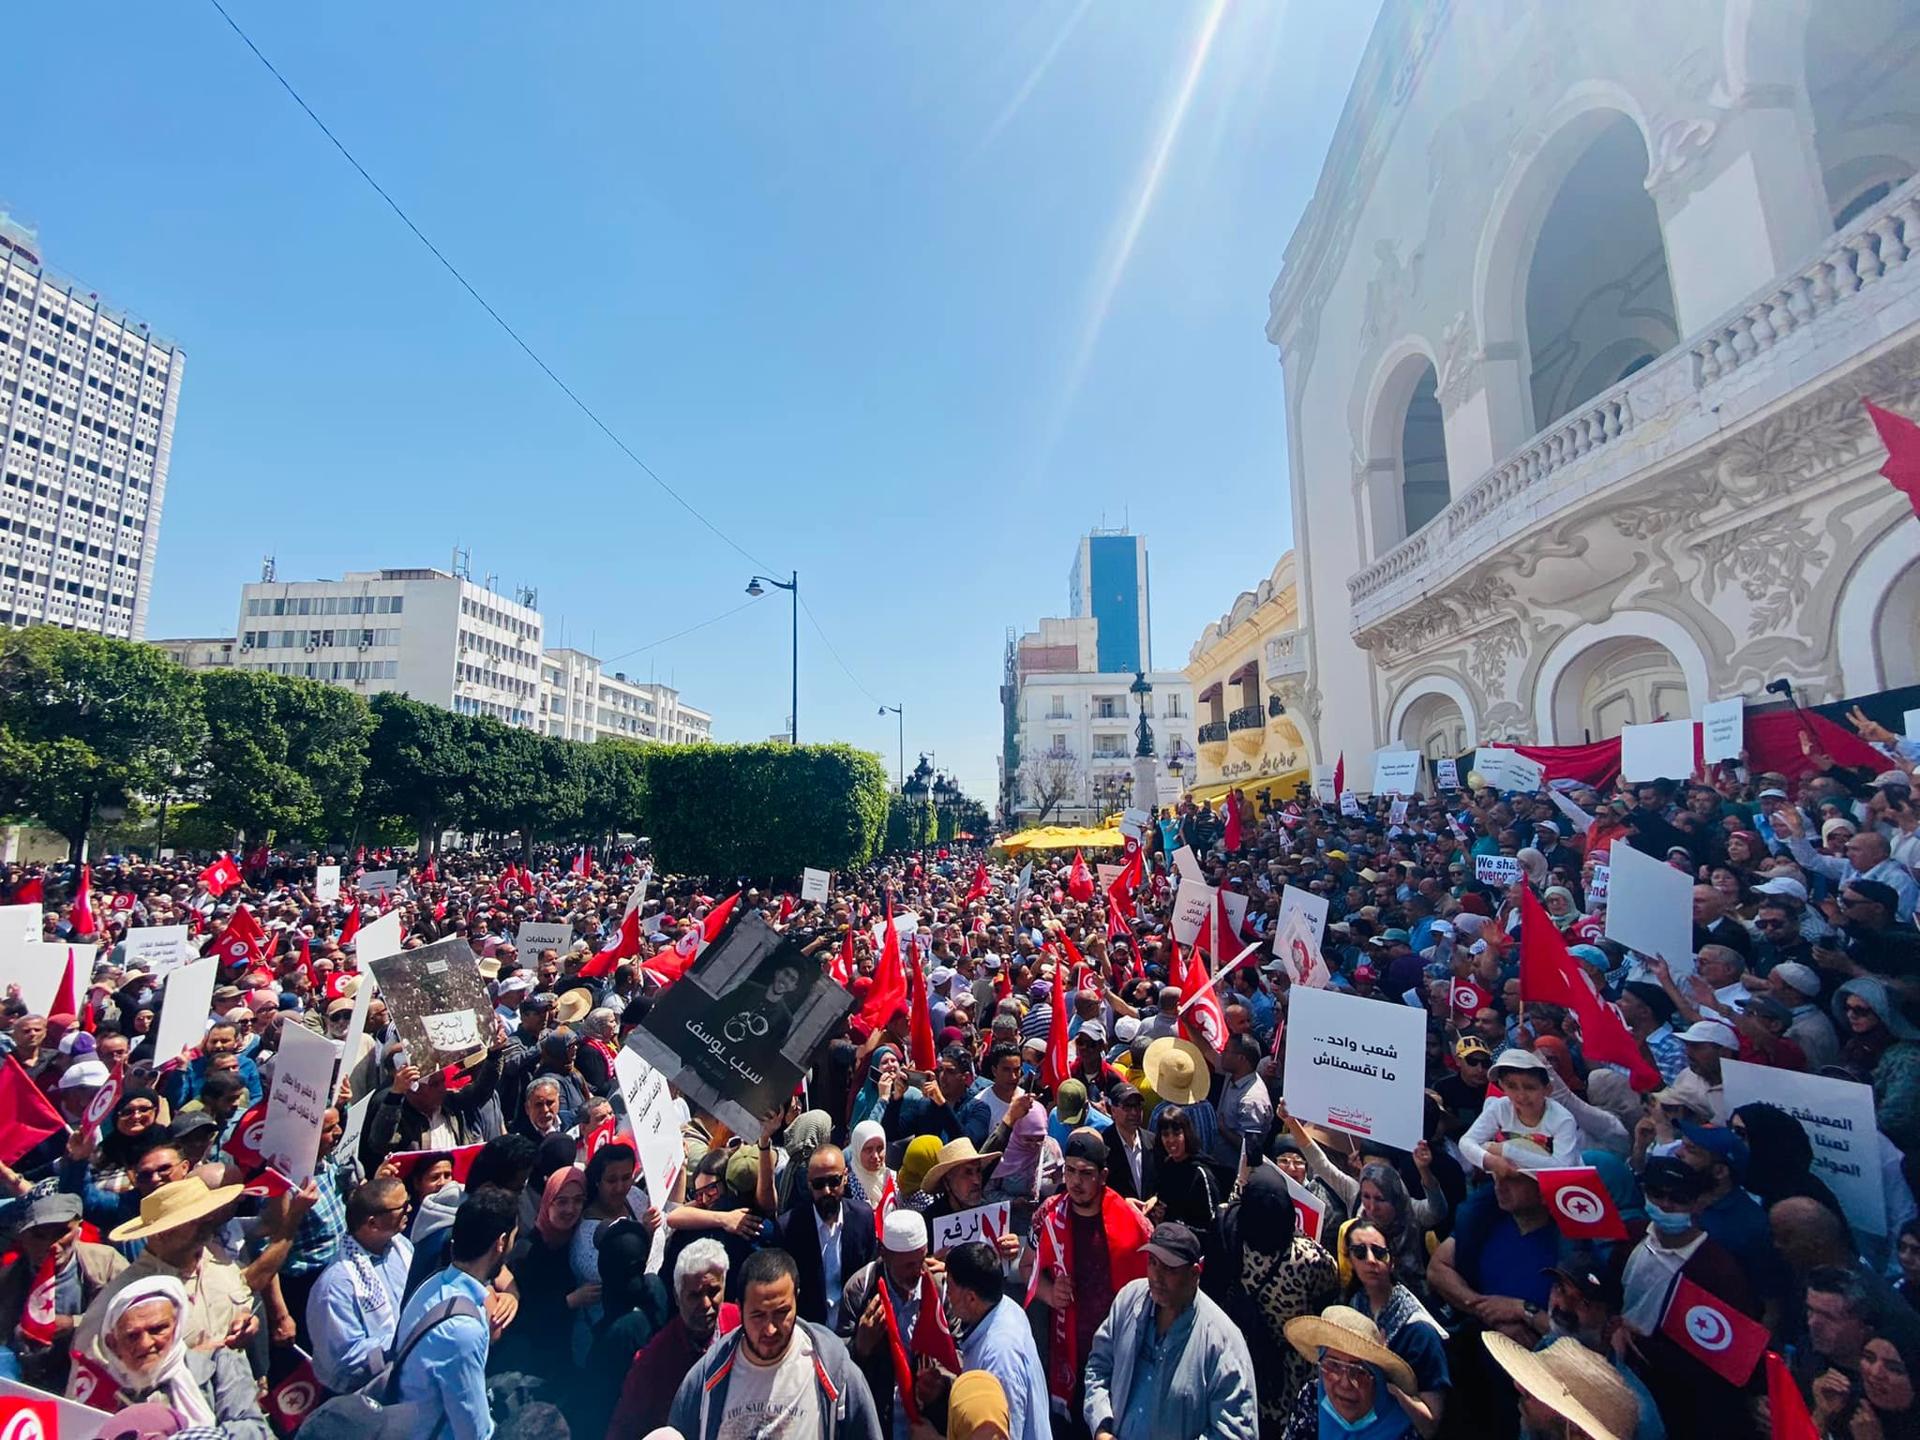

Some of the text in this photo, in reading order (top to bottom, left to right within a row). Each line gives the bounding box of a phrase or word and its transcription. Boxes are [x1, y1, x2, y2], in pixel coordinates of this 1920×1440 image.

[1478, 857, 1493, 868] We
[1328, 1035, 1358, 1052] واحد
[1362, 1044, 1398, 1059] شعب
[1312, 1052, 1396, 1081] ما تقسمناش
[1791, 1106, 1852, 1131] المعيشة
[1814, 1134, 1850, 1152] تعبنا
[942, 1212, 979, 1248] لرفع
